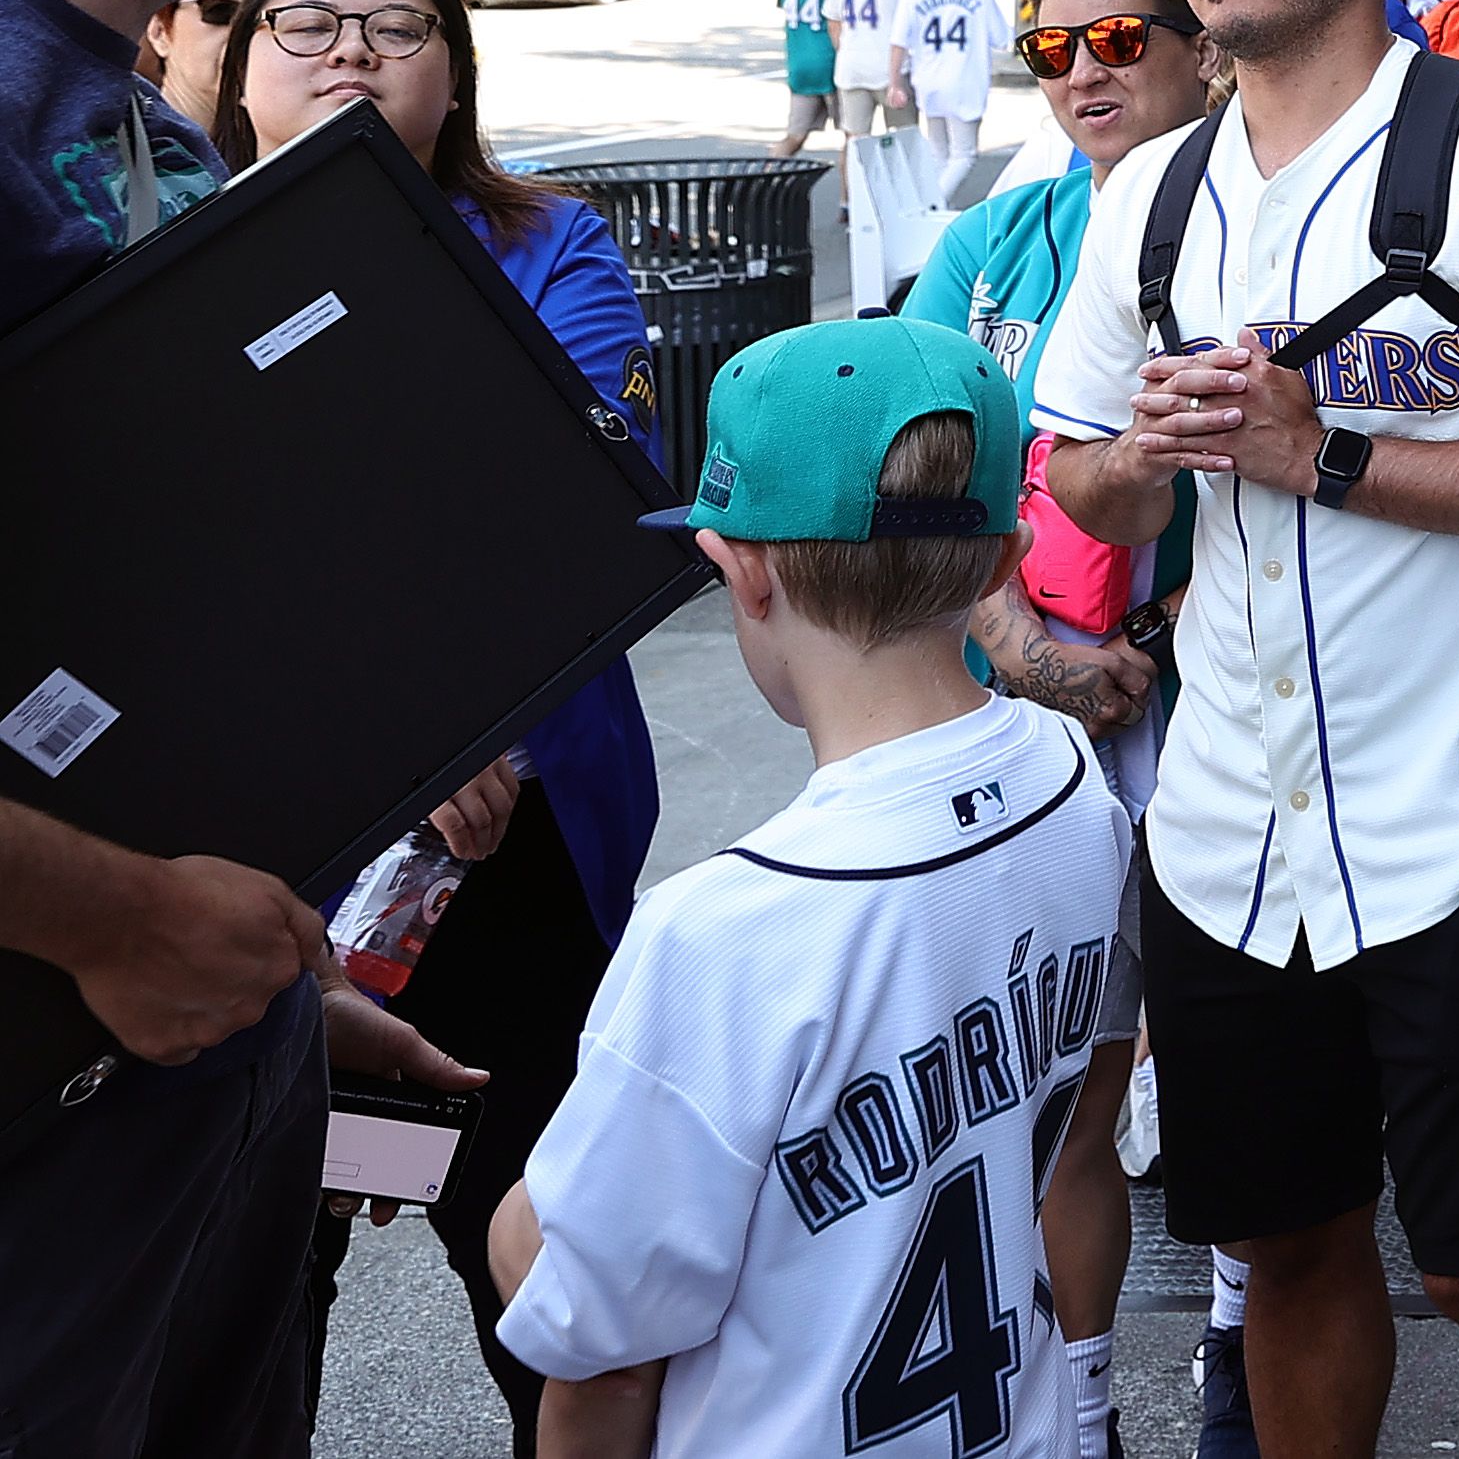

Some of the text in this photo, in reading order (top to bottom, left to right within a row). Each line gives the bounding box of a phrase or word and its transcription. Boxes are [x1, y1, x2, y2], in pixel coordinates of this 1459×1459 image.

[924, 15, 966, 52] 44
[622, 371, 657, 416] PN
[775, 927, 1119, 1236] RODRÍGU
